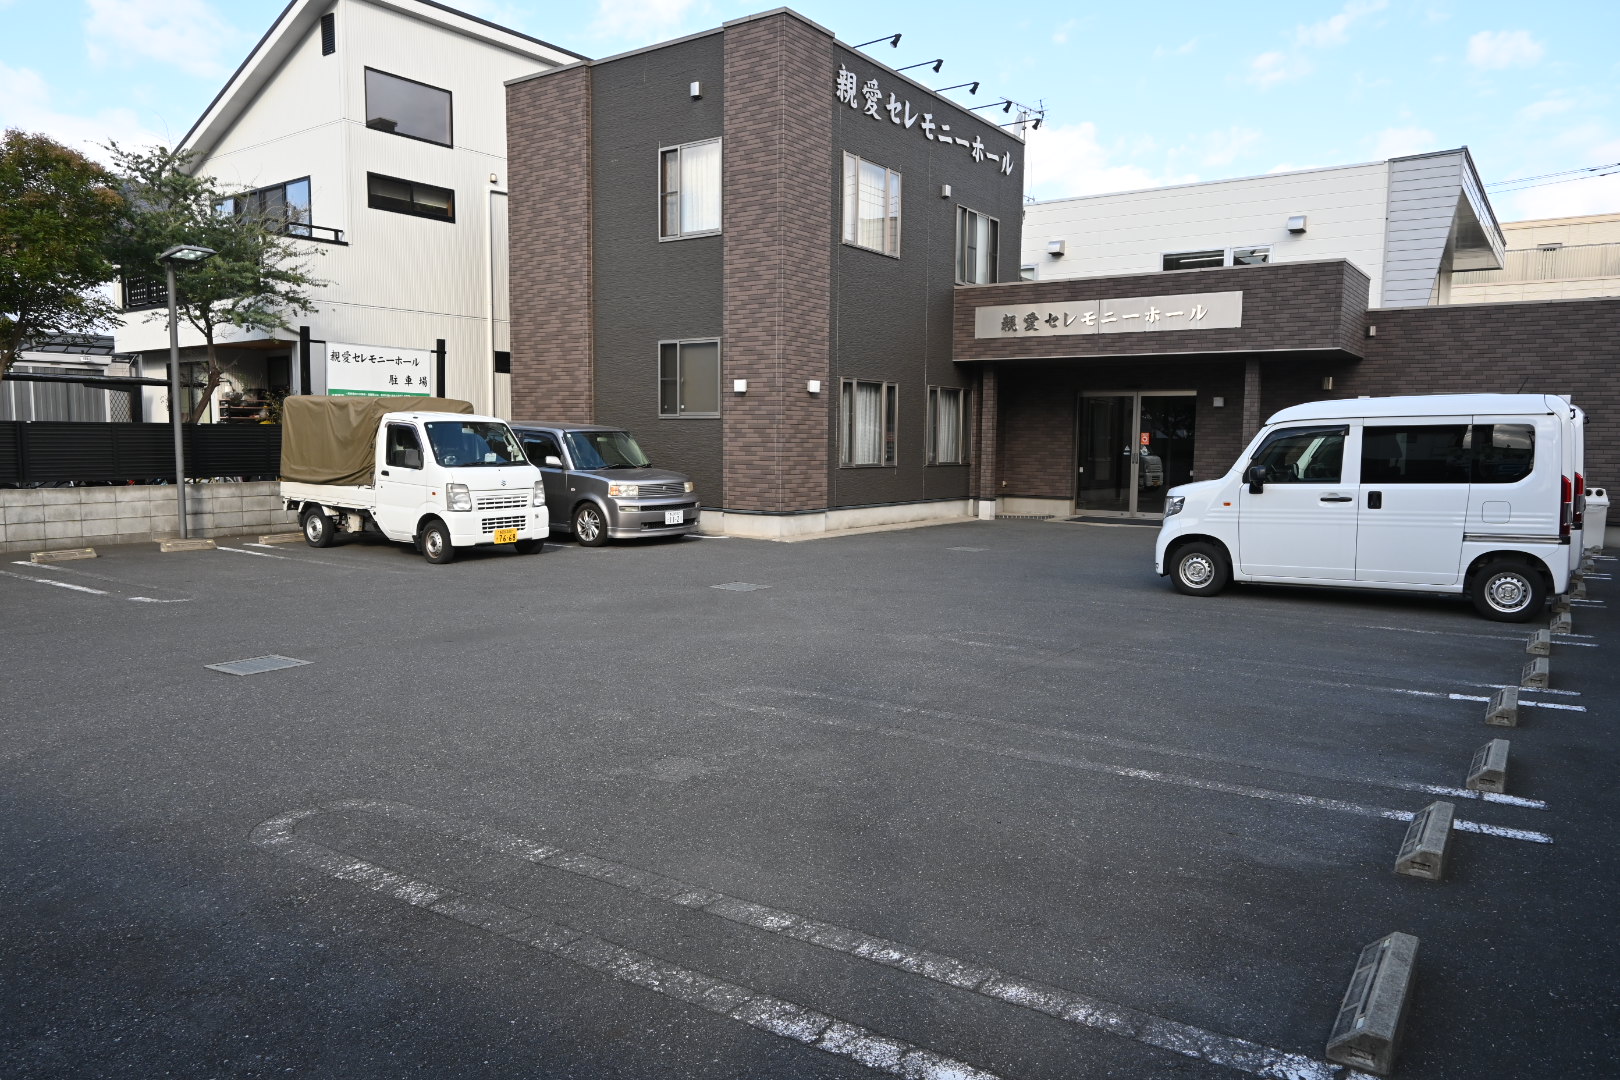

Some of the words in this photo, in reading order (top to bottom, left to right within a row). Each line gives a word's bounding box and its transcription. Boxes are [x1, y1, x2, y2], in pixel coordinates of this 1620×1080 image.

[836, 63, 1014, 176] 親愛セレモニーホール
[1001, 304, 1208, 332] 親愛セレモニーホール
[330, 350, 420, 367] 親愛セレモニーホール
[388, 374, 428, 388] 駐車場
